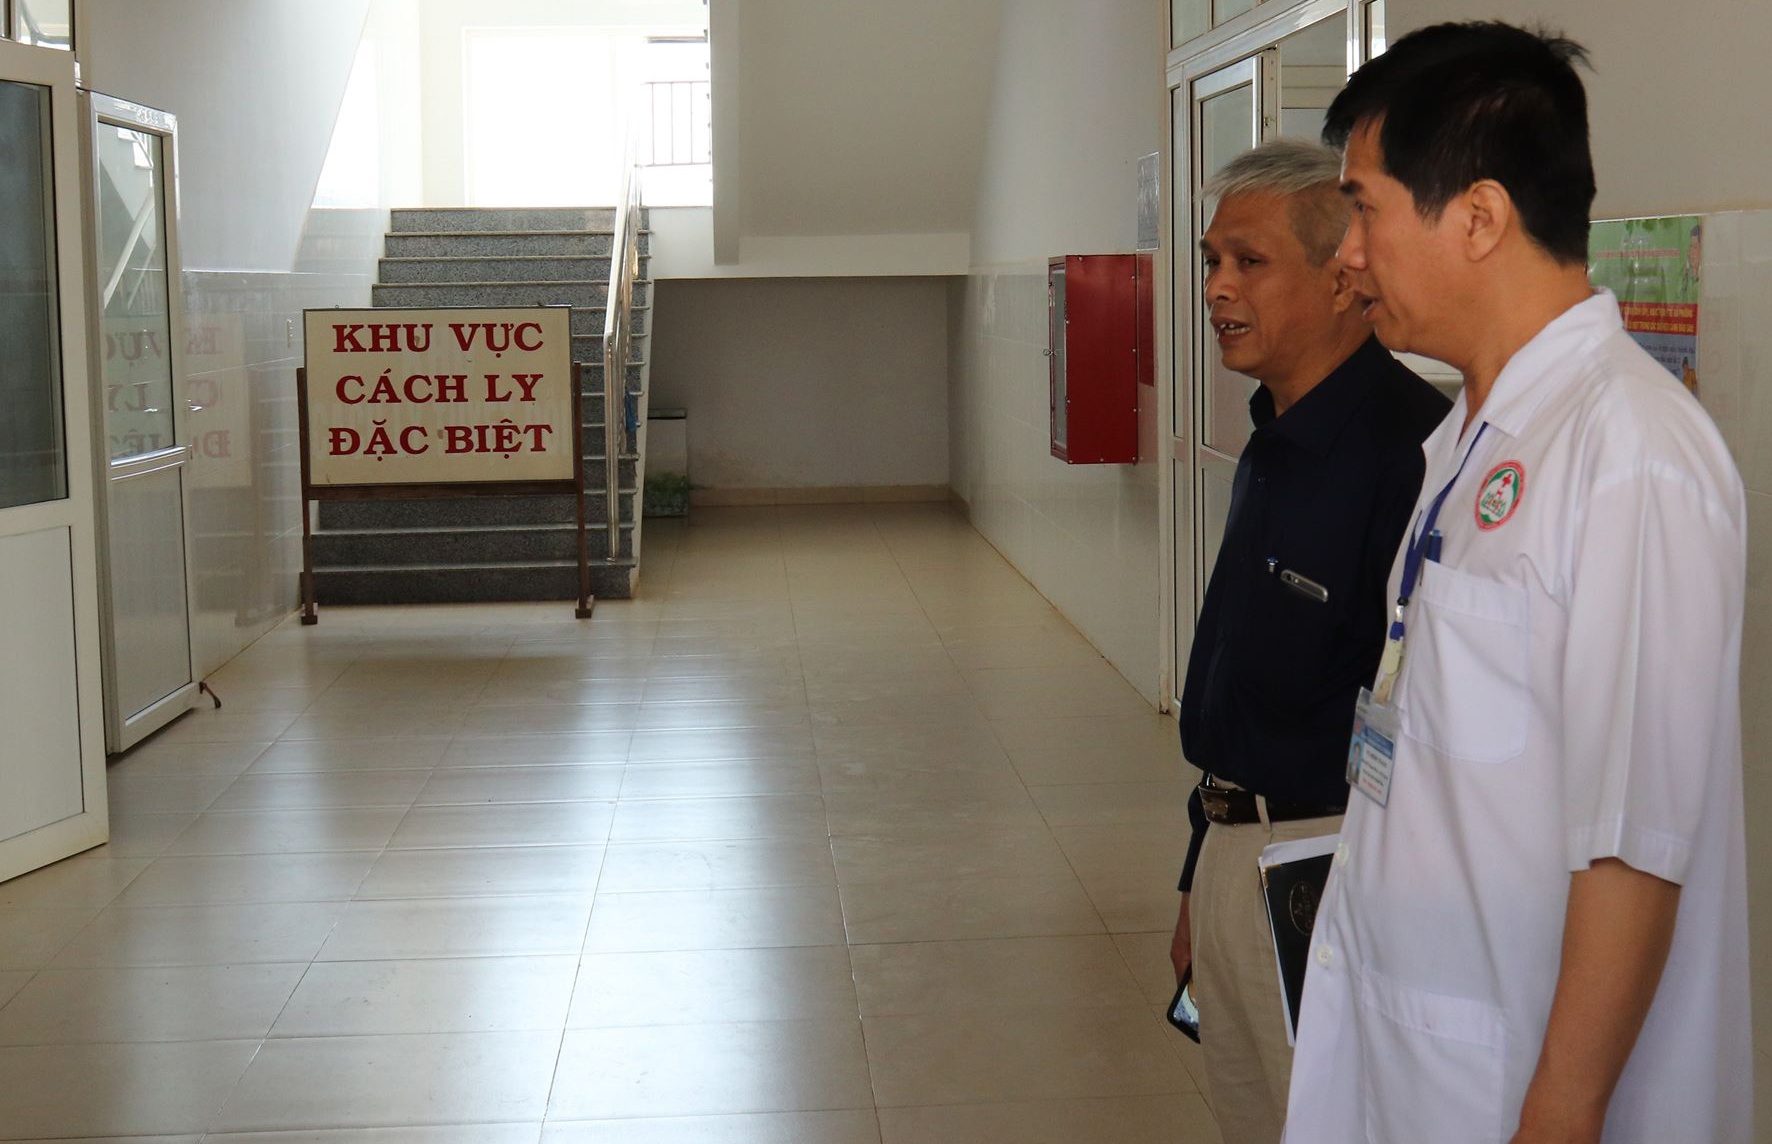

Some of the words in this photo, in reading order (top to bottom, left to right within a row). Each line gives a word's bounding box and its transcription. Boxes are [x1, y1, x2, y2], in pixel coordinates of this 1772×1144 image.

[332, 324, 433, 352] KHU
[449, 322, 544, 358] VỰC
[336, 368, 468, 404] CÁCH
[485, 374, 543, 402] LY
[329, 419, 429, 462] ĐẶC
[445, 419, 552, 459] BIỆT
